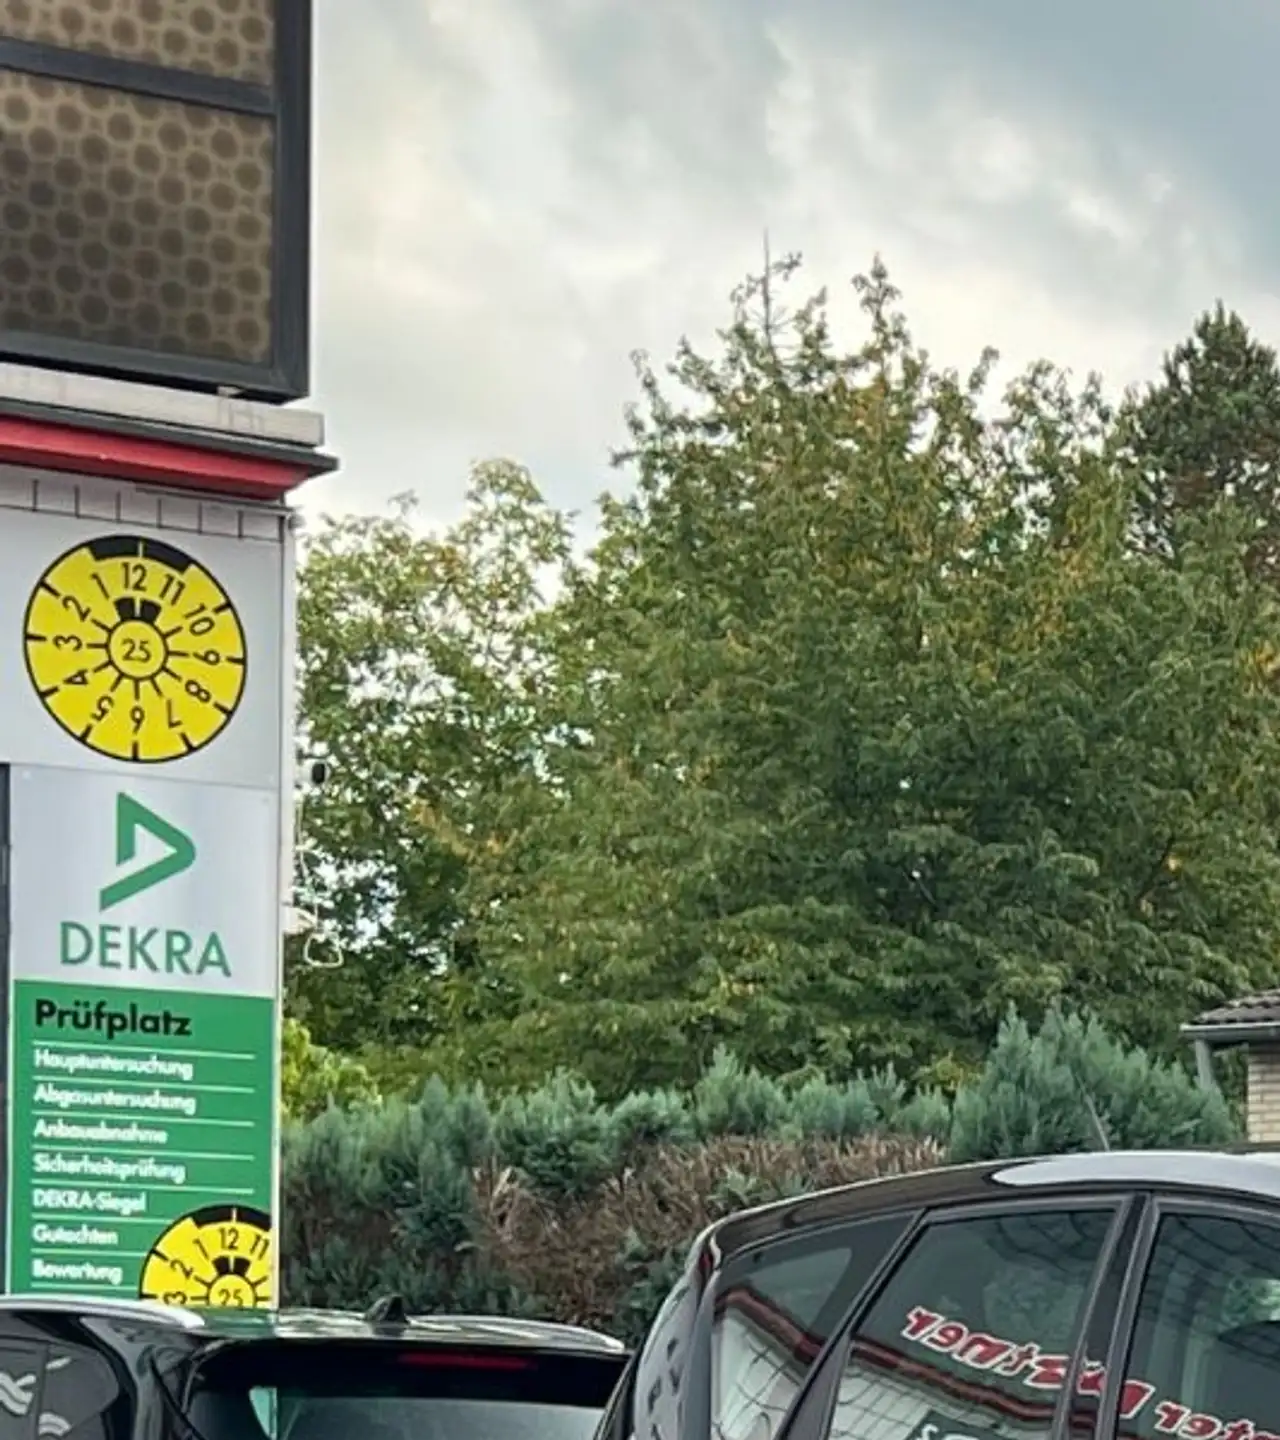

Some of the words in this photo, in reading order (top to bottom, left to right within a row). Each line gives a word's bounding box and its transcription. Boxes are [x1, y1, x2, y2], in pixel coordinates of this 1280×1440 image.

[91, 573, 111, 600] 1
[122, 561, 148, 592] 12
[159, 573, 187, 606] 11
[62, 595, 91, 622] 2
[184, 603, 216, 637] 10
[54, 634, 83, 652] 3
[121, 638, 152, 663] 25
[63, 668, 89, 686] 4
[184, 679, 212, 704] 8
[90, 695, 115, 721] 5
[166, 698, 182, 728] 7
[60, 921, 232, 978] DEKRA
[34, 998, 193, 1040] Prüfplatz
[34, 1048, 194, 1081] Hauptuntersuchung
[33, 1082, 196, 1116] Abgasuntersuchung
[32, 1153, 186, 1185] Sicherheitsprüfung
[32, 1188, 147, 1216] DEKRA-Siegel
[32, 1223, 119, 1245] Gutachten
[218, 1227, 239, 1250] 12
[192, 1238, 210, 1260] 1
[32, 1257, 123, 1286] Bewertung
[170, 1259, 193, 1280] 2
